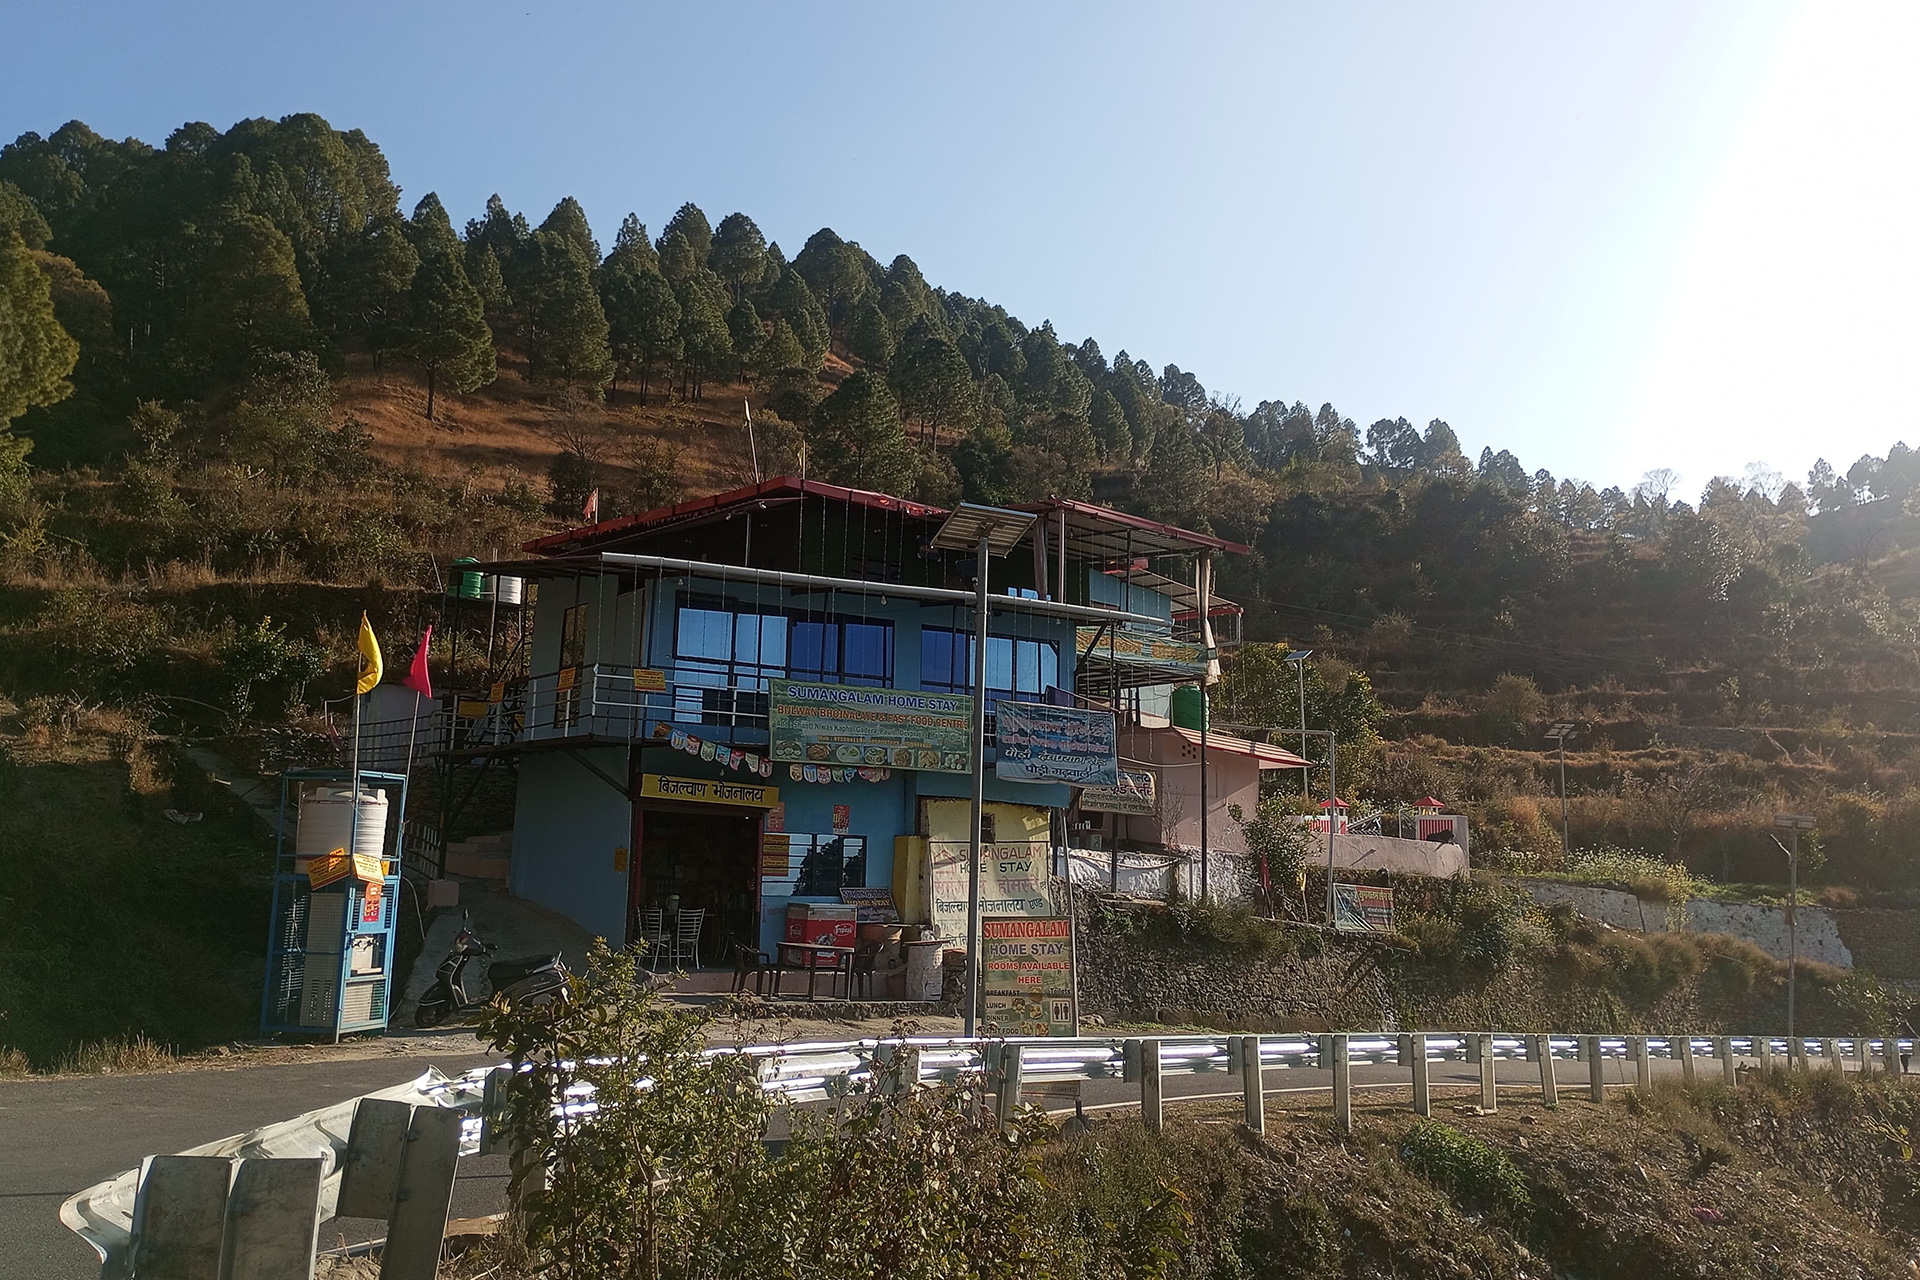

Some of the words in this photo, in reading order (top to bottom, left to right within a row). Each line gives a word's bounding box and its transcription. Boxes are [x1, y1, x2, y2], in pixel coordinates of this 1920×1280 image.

[788, 685, 884, 705] SUMANGALAM
[888, 695, 925, 709] HOME
[928, 699, 958, 712] STAY
[777, 704, 817, 718] BIJLWAN
[878, 713, 885, 722] &
[887, 713, 908, 724] FAST
[911, 715, 934, 727] FOOD
[936, 718, 968, 729] CENTRE
[658, 775, 708, 797] बिजल्वाण
[712, 782, 765, 802] भोजनालय
[960, 863, 987, 874] HOE
[999, 861, 1033, 873] STAY
[984, 920, 1069, 938] SUMANGALAM
[990, 944, 1027, 956] HOME
[1031, 943, 1063, 955] STAY
[988, 962, 1019, 970] ROOMS
[1021, 961, 1070, 970] AVAILABLE
[1017, 976, 1042, 984] HERE
[985, 989, 1021, 997] BREAKFAST
[1002, 1027, 1020, 1035] FOOD
